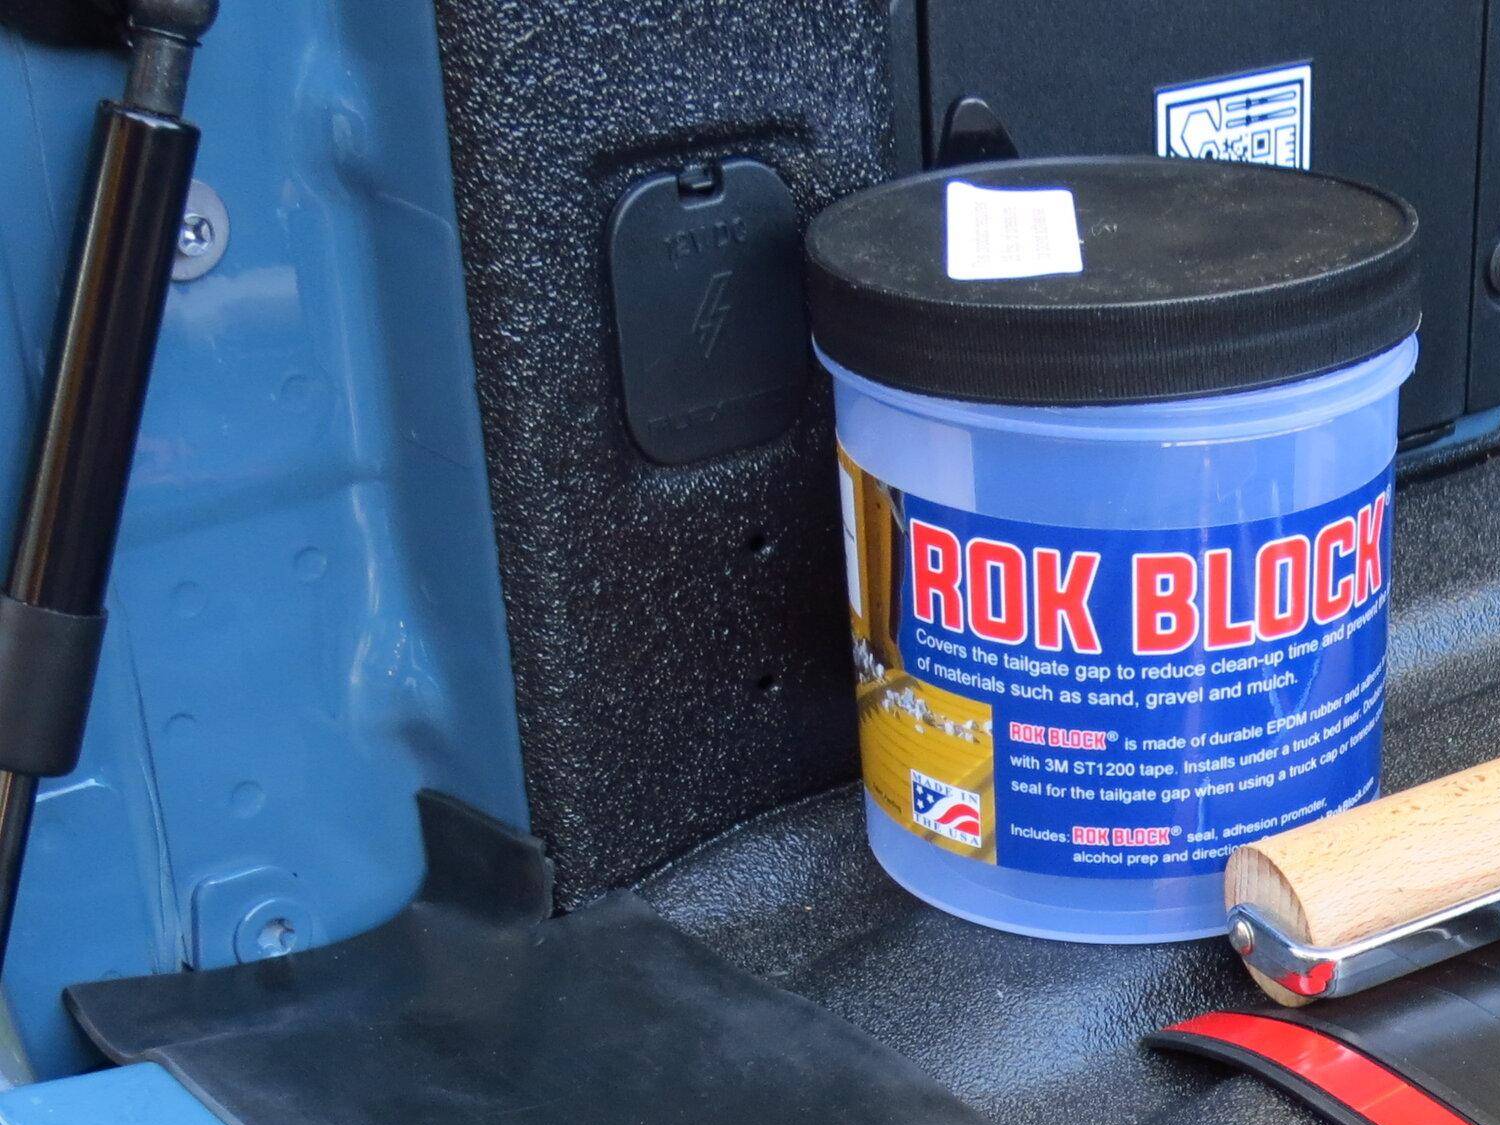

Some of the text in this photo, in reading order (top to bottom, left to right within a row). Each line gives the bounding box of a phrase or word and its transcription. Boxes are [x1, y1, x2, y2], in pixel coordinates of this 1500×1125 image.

[909, 518, 1103, 656] ROK
[916, 628, 968, 659] Covers
[972, 646, 999, 666] the
[1003, 652, 1070, 679] tailgate
[1075, 665, 1111, 682] gap
[1117, 664, 1136, 681] to
[1141, 660, 1206, 680] reduce
[1210, 650, 1284, 675] clean-up
[1288, 638, 1319, 659] time
[1321, 628, 1345, 648] and
[1346, 604, 1379, 640] prevent
[917, 656, 1299, 710] of materials such as sand, gravel and mulch.
[1009, 721, 1045, 745] ROK
[1124, 738, 1138, 751] is
[1143, 735, 1187, 751] made
[1190, 732, 1206, 749] of
[1209, 725, 1264, 747] durable
[1266, 712, 1308, 734] EPDM
[1310, 695, 1343, 722] rubber
[1344, 685, 1361, 705] and
[1010, 754, 1041, 772] with
[1045, 758, 1069, 774] 3M
[1073, 761, 1136, 777] ST1200
[1140, 761, 1179, 779] tape.
[1184, 754, 1236, 775] Installs
[1240, 745, 1280, 767] under
[1281, 744, 1291, 756] a
[1292, 731, 1321, 752] truck
[1323, 720, 1342, 740] bed
[1011, 779, 1042, 796] seal
[1045, 783, 1067, 798] for
[1070, 785, 1095, 801] the
[1099, 787, 1157, 807] tailgate
[1160, 787, 1191, 804] gap
[1195, 780, 1235, 798] when
[1238, 773, 1275, 793] using
[1277, 769, 1287, 781] a
[1289, 758, 1318, 779] truck
[1319, 748, 1339, 767] cap
[1339, 741, 1350, 755] or
[911, 770, 980, 805] MADE IN
[915, 813, 981, 846] THE USA
[1010, 823, 1071, 844] Includes:
[1071, 825, 1110, 847] ROK
[1186, 828, 1219, 844] seal,
[1222, 816, 1278, 839] adhesion
[1072, 850, 1124, 866] alcohol
[1127, 853, 1159, 869] prep
[1162, 850, 1189, 864] and
